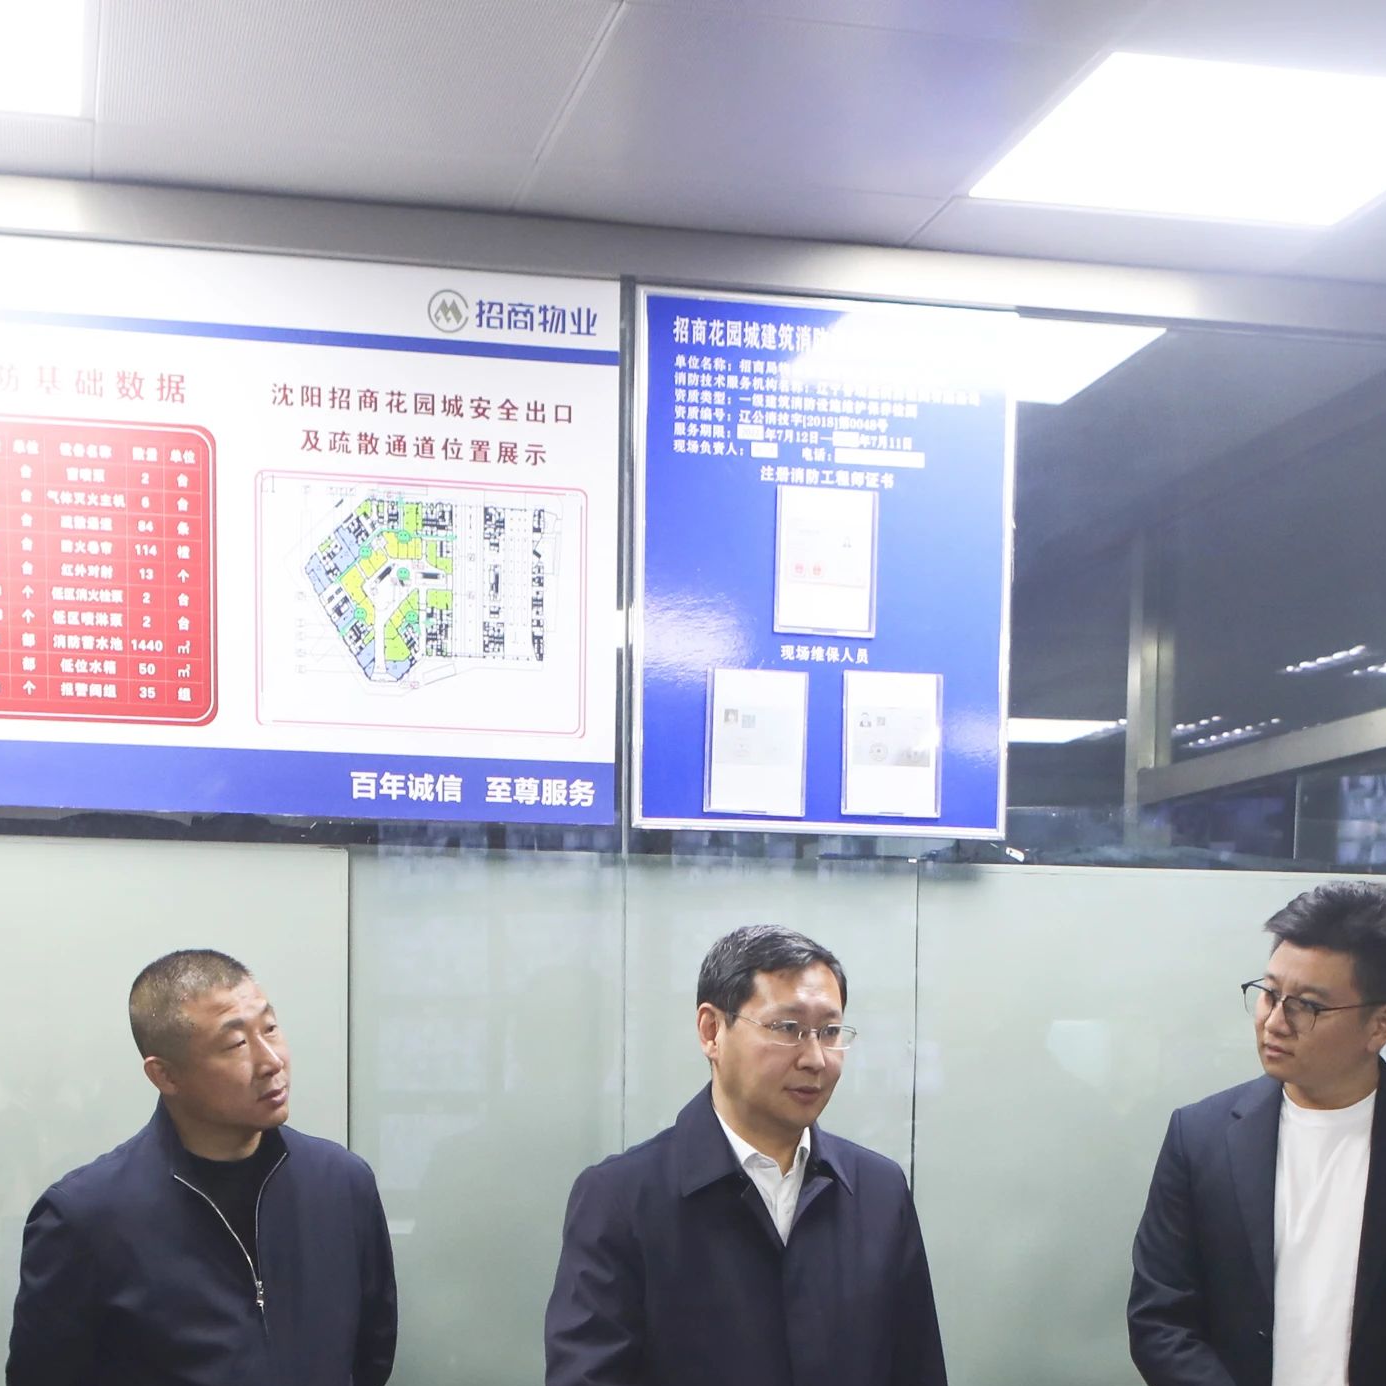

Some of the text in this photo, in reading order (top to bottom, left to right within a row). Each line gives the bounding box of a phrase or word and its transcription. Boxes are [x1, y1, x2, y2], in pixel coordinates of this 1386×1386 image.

[475, 298, 598, 338] 招商物业
[271, 383, 575, 425] 沈阳招商花园城安全出口
[301, 428, 548, 467] 及疏散通道位置展示
[20, 464, 32, 479] 台
[141, 472, 150, 484] 2
[177, 473, 188, 487] 台
[760, 465, 895, 488] 注册消防工程师证书
[20, 489, 32, 502] 台
[46, 490, 126, 508] 气体灭火主机
[177, 497, 189, 511] 台
[20, 513, 33, 527] 台
[60, 515, 112, 531] 疏散通道
[177, 521, 190, 535] 条
[21, 537, 33, 551] 台
[60, 539, 112, 555] 防火卷帘
[134, 544, 157, 556] 114
[22, 561, 33, 575] 台
[61, 563, 113, 579] 红外对射
[139, 568, 154, 580] 13
[177, 569, 190, 583] 个
[22, 585, 34, 598] 个
[51, 586, 123, 603] 低区消火栓泵
[142, 592, 151, 604] 2
[178, 593, 189, 607] 台
[21, 609, 35, 623] 个
[52, 610, 123, 627] 低区喷淋泵
[142, 615, 151, 628] 2
[177, 616, 190, 631] 台
[22, 632, 36, 647] 部
[53, 634, 123, 651] 消防蓄水池
[131, 639, 163, 652] 1440
[22, 656, 36, 671] 部
[60, 658, 116, 674] 低位水箱
[138, 663, 156, 675] 50
[780, 644, 869, 665] 现场维保人员
[22, 680, 36, 695] 个
[60, 682, 117, 698] 报警阀组
[139, 686, 156, 699] 35
[177, 687, 192, 702] 组
[350, 770, 596, 808] 百年诚信 至尊服务
